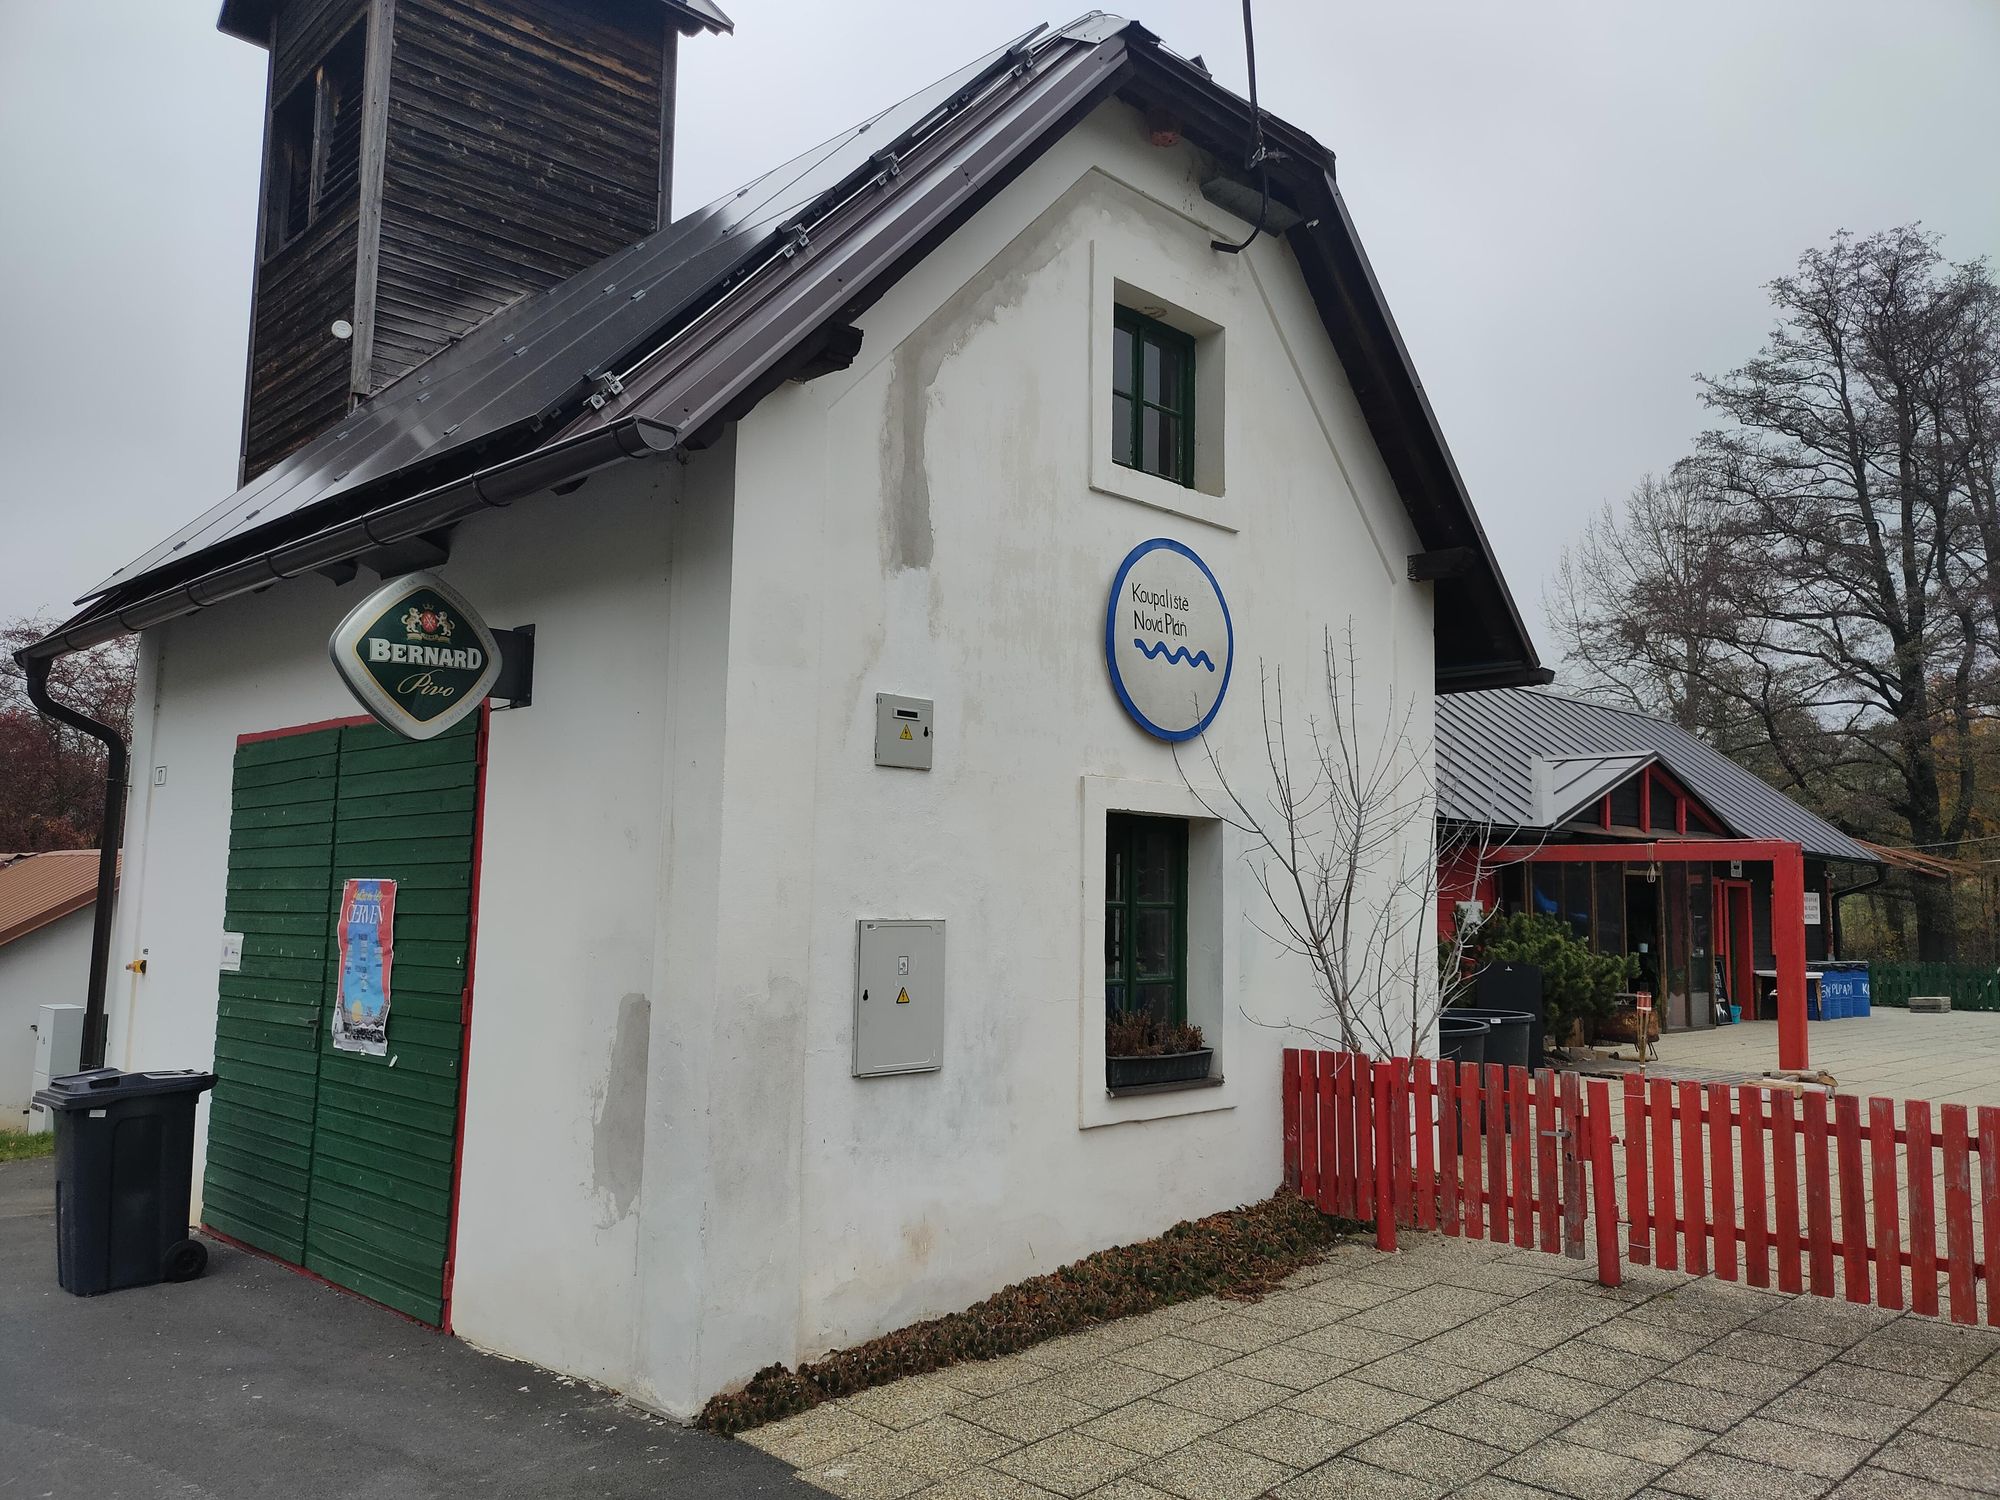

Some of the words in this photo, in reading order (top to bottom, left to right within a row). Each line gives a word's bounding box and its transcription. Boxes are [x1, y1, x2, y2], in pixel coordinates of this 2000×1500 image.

[1132, 583, 1189, 612] Koupaliště
[1133, 610, 1163, 632] Nová
[368, 638, 482, 670] BERNARD
[397, 670, 456, 697] Pivo
